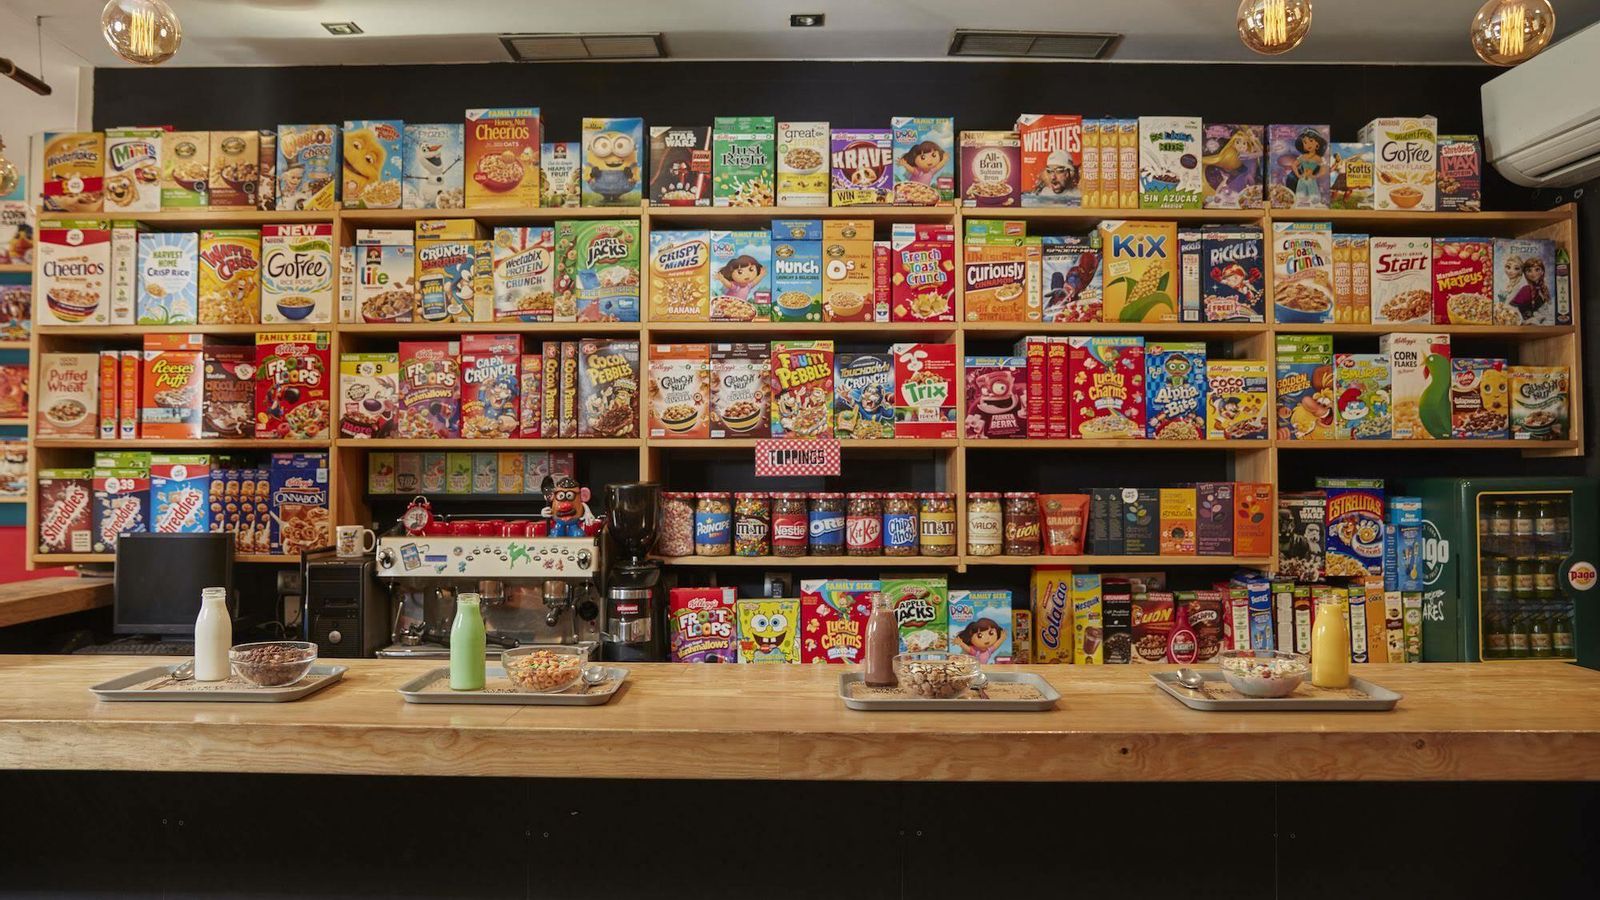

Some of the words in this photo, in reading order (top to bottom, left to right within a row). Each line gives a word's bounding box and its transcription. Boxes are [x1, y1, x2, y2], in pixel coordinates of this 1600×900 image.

[475, 124, 530, 141] Cheerios
[668, 130, 695, 140] STAR
[784, 128, 816, 142] great
[1023, 125, 1081, 153] WHEATIES
[665, 138, 697, 148] WARS
[729, 144, 763, 156] Just
[720, 151, 768, 169] Right
[831, 148, 893, 169] KRAVE
[979, 160, 1003, 168] Bran
[1347, 163, 1371, 174] Scotts
[837, 191, 855, 201] WIN
[1144, 194, 1159, 203] SIN
[1163, 194, 1198, 203] AZUCAR
[278, 225, 318, 236] NEW
[593, 239, 618, 248] APPLE
[152, 250, 184, 260] HARVEST
[419, 244, 469, 261] CRUNCH
[505, 250, 542, 268] Weetabix
[587, 244, 627, 267] JACKS
[902, 248, 941, 263] French
[43, 260, 105, 279] Cheerios
[157, 260, 179, 269] HOME
[505, 261, 543, 276] PROTEIN
[775, 259, 819, 274] Munch
[909, 261, 938, 273] Toast
[1376, 254, 1428, 274] Start
[360, 266, 389, 285] life
[906, 271, 948, 286] Crunch
[967, 263, 1025, 285] Curiously
[668, 306, 700, 315] BANANA
[259, 334, 290, 342] FAMILY
[292, 334, 312, 342] SIZE
[587, 354, 627, 369] COCOA
[1393, 351, 1417, 360] CORN
[50, 369, 88, 382] Puffed
[156, 373, 189, 388] Puffs
[464, 363, 517, 384] CRUNCH
[586, 364, 633, 386] PEBBLES
[775, 363, 831, 389] PEBBLES
[47, 382, 85, 393] Wheat
[844, 373, 888, 390] CRUNCH
[904, 378, 946, 403] Trix
[1155, 386, 1198, 403] Alpha
[1165, 397, 1197, 417] Bits
[989, 419, 1018, 429] BERRY
[769, 450, 825, 465] TOPPINGS
[44, 490, 84, 541] Shreddies
[1328, 496, 1382, 522] ESTRELLITAS
[103, 499, 137, 541] Shreddies
[888, 518, 912, 534] Chips
[971, 521, 998, 530] VALOR
[1570, 570, 1595, 581] pago
[899, 600, 926, 608] APPLE
[1074, 597, 1100, 612] Nesquik
[1142, 608, 1172, 624] LION
[821, 632, 862, 649] Charms
